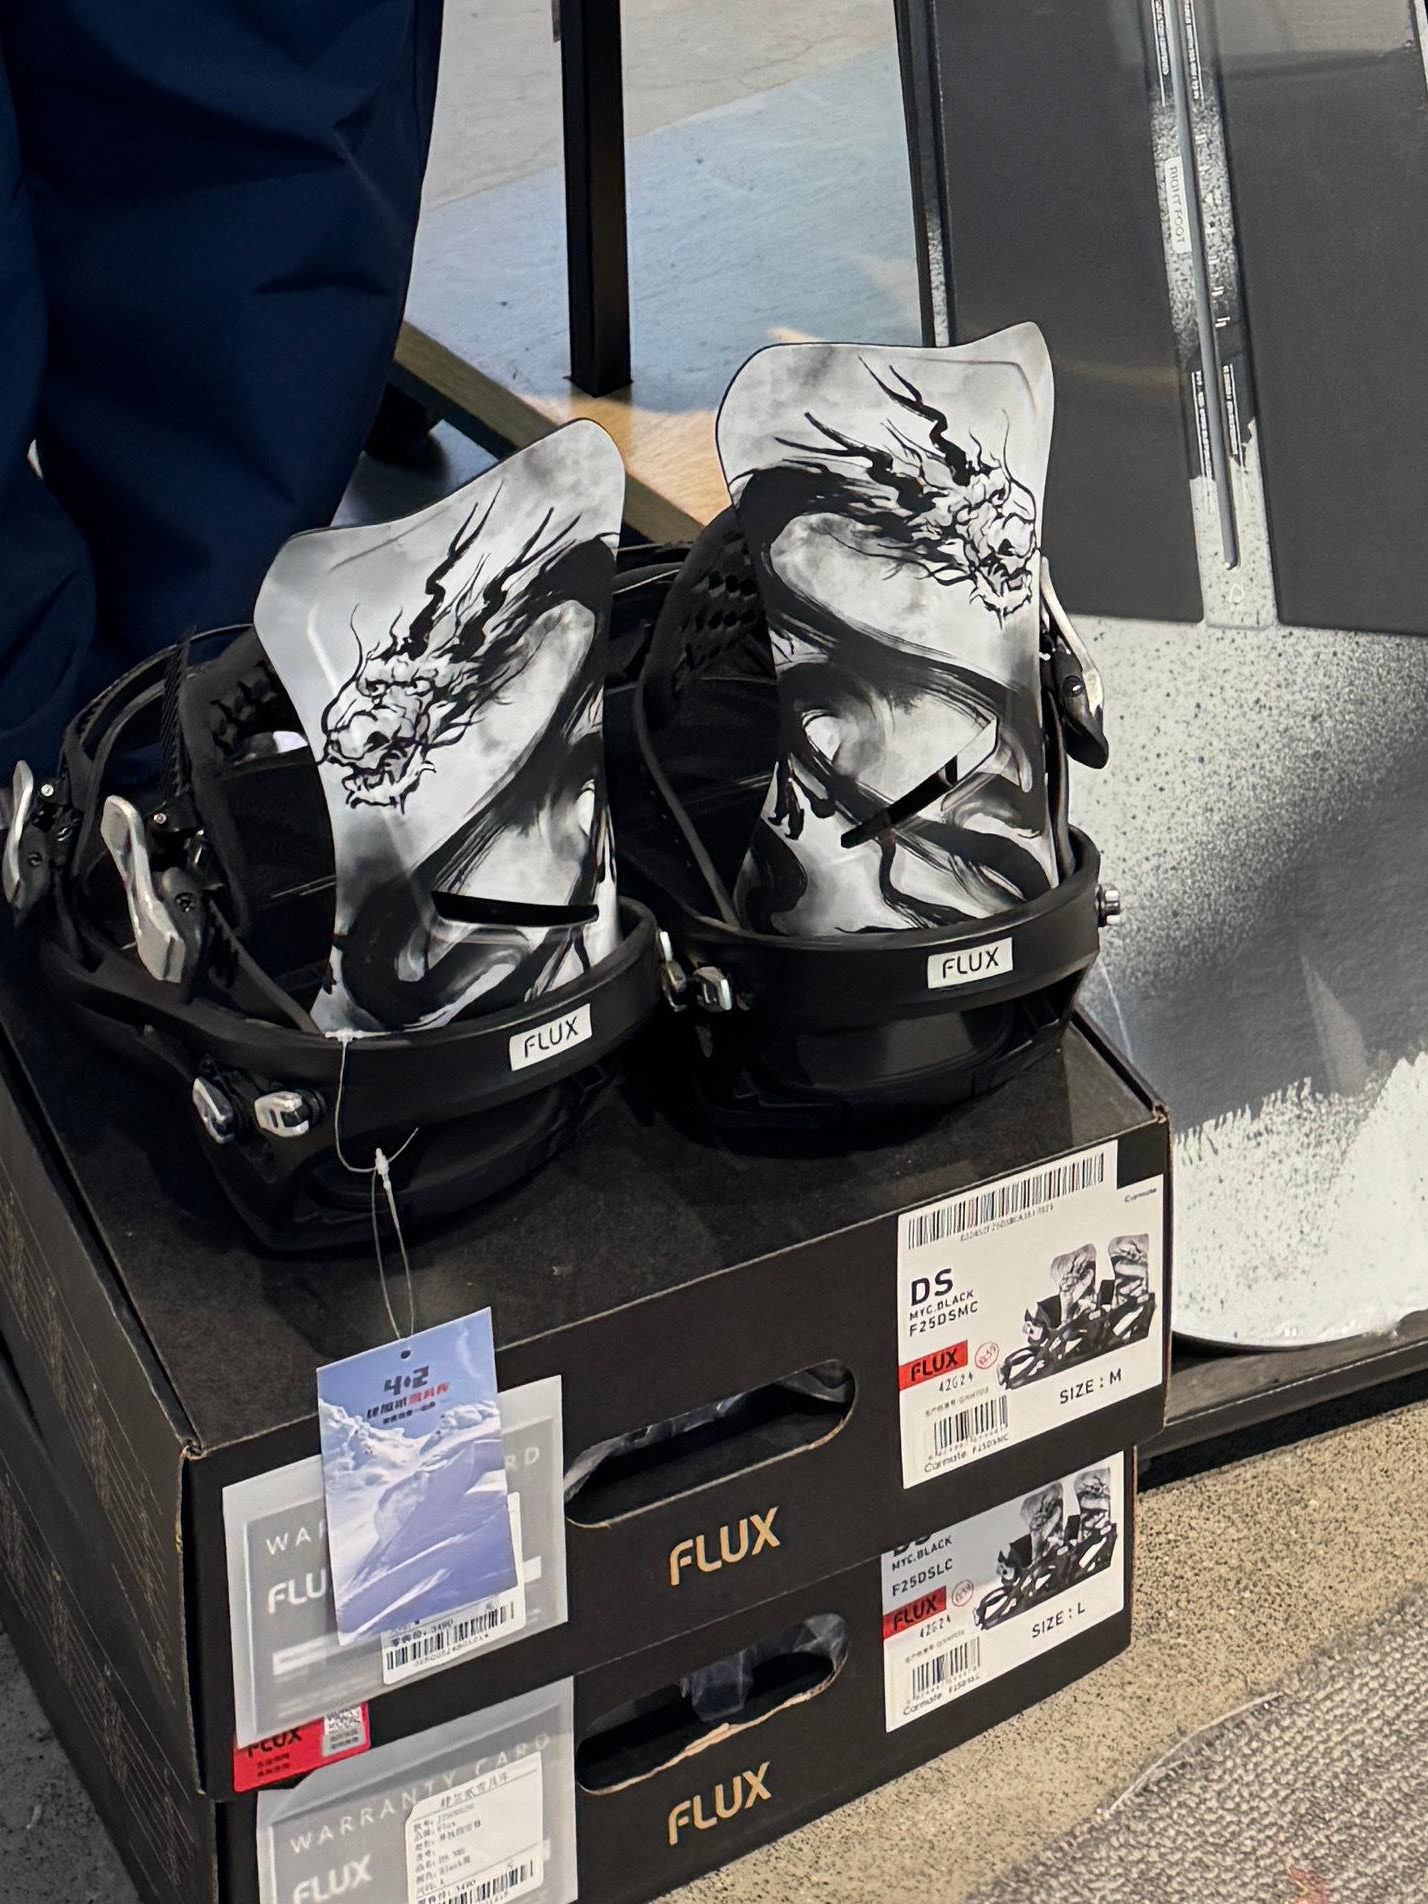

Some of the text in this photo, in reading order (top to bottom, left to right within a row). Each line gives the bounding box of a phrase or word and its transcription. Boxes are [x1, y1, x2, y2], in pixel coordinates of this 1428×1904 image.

[942, 946, 1000, 980] FLUX
[524, 1015, 579, 1059] FLUX
[908, 1289, 974, 1322] MYC.BLACK
[910, 1267, 954, 1307] DS
[908, 1300, 979, 1337] F25DSMC
[910, 1349, 960, 1383] FLUX
[1060, 1381, 1095, 1405] SIZE
[1109, 1368, 1122, 1385] M
[669, 1506, 781, 1586] FLUX
[891, 1535, 953, 1571] MYC.BLACK
[268, 1568, 329, 1615] FLU
[892, 1558, 954, 1597] F25DSLC
[892, 1594, 939, 1632] FLUX
[1031, 1615, 1065, 1639] SIZE
[1077, 1601, 1086, 1615] L
[290, 1770, 457, 1854] WARRANTY
[668, 1761, 772, 1846] FLUX
[293, 1854, 373, 1904] FLUX
